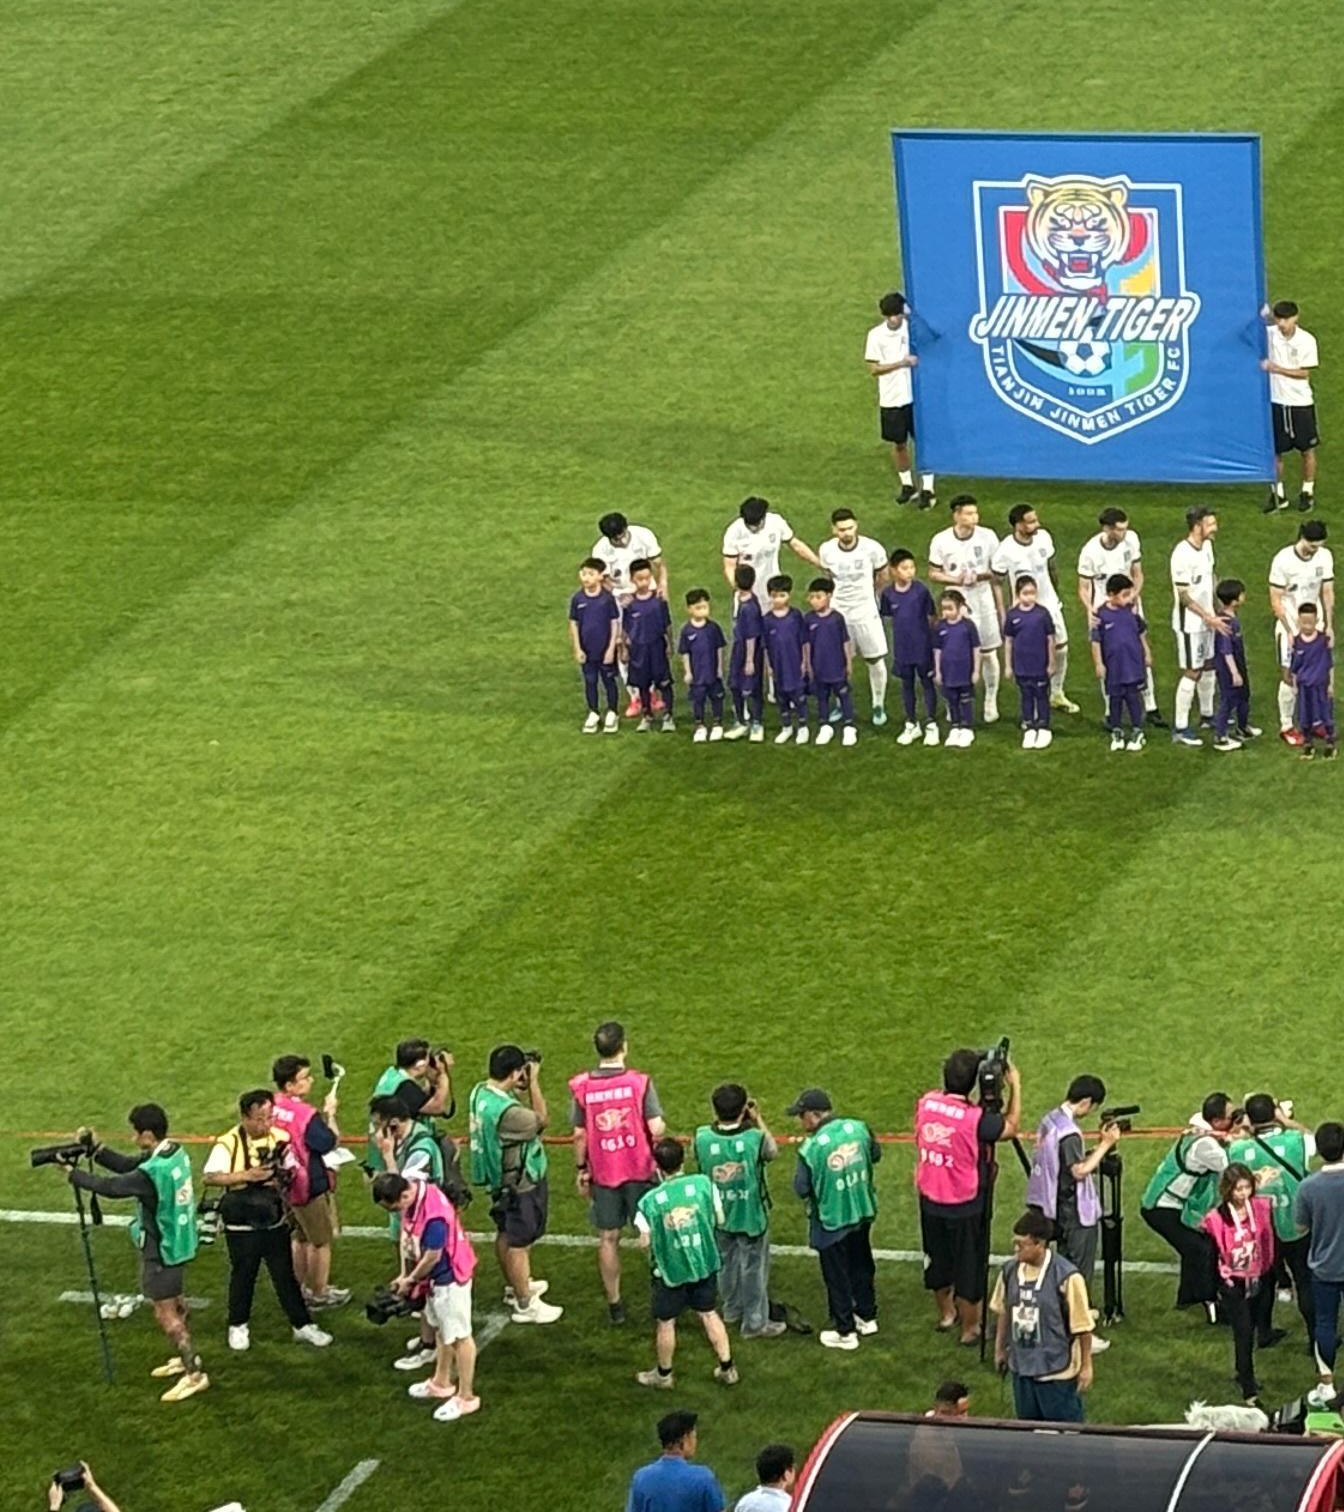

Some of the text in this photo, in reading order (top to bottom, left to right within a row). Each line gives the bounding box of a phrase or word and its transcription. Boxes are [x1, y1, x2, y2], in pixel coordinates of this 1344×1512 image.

[980, 295, 1192, 341] JINMEN TIGER
[991, 345, 1182, 431] TIANJIN JINMEN TIGER FC
